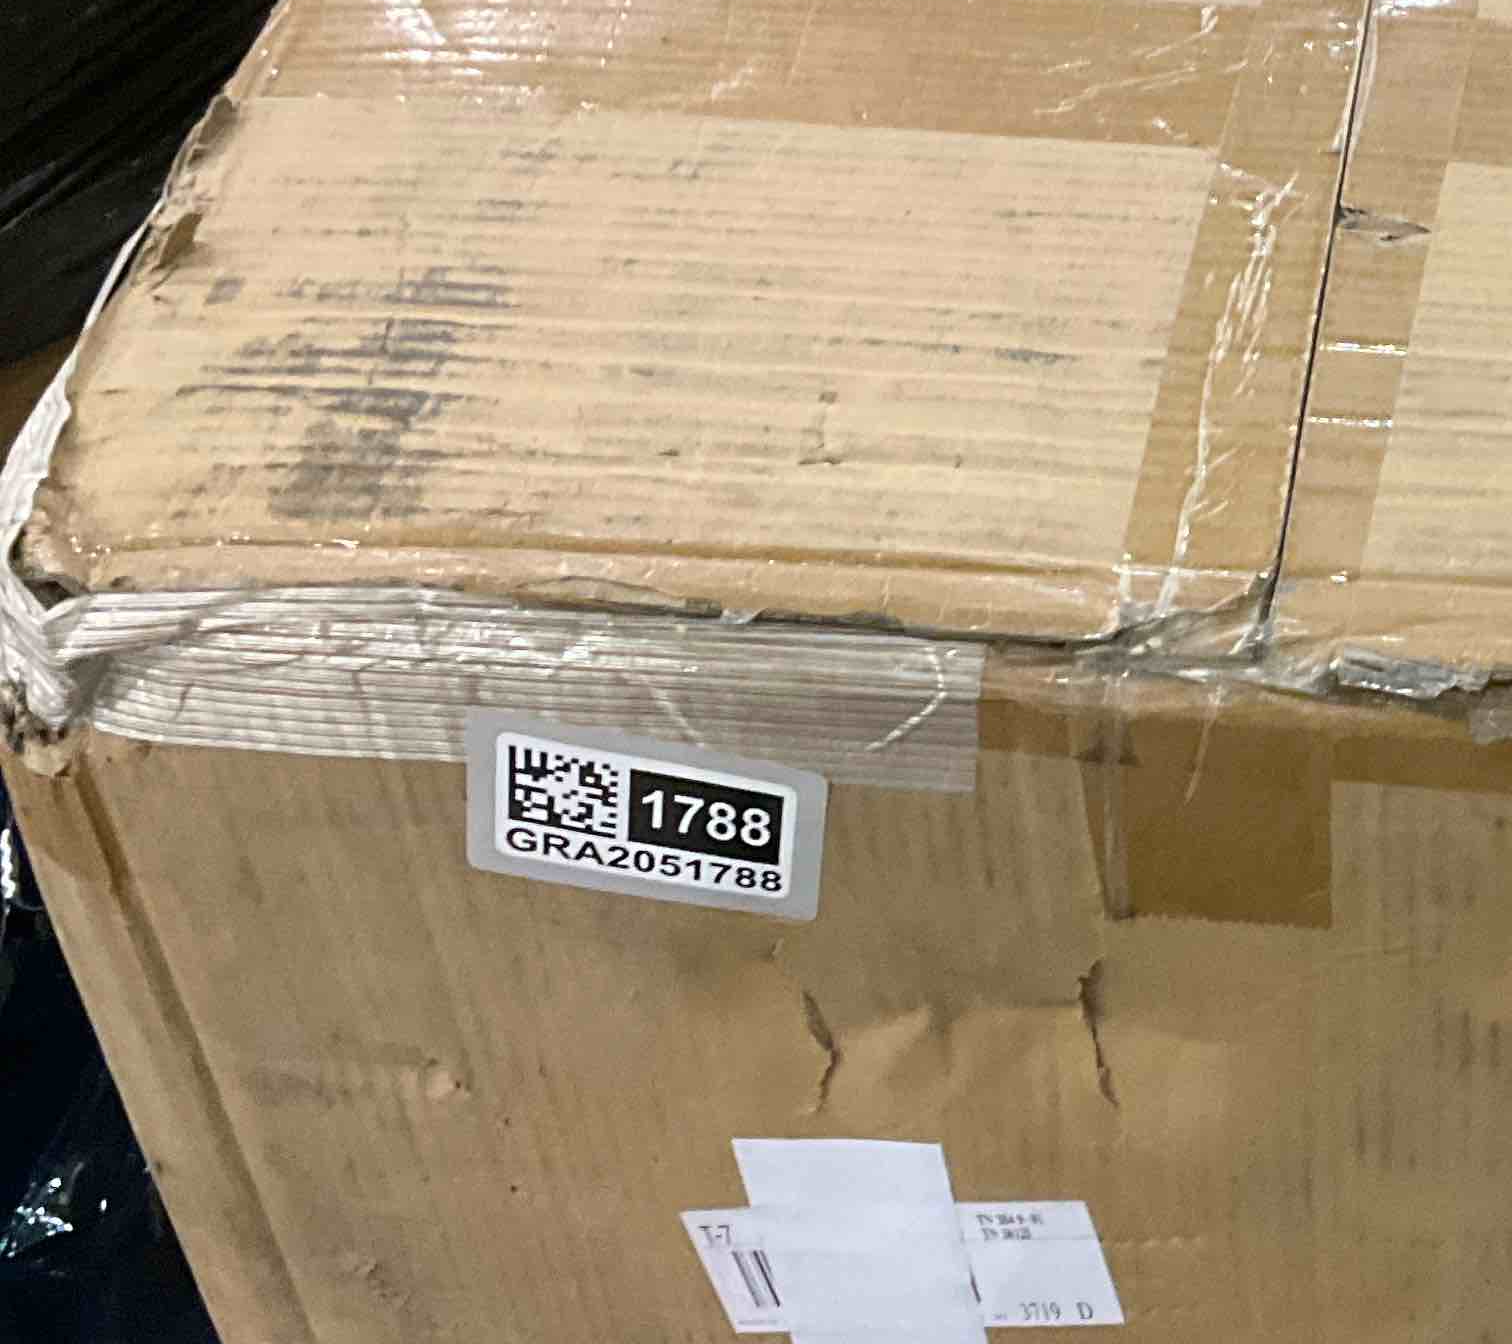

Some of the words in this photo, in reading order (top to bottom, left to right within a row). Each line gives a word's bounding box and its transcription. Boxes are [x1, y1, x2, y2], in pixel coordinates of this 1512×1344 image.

[640, 788, 772, 848] 1788
[506, 826, 784, 893] GRA2051788
[1076, 1301, 1095, 1320] D
